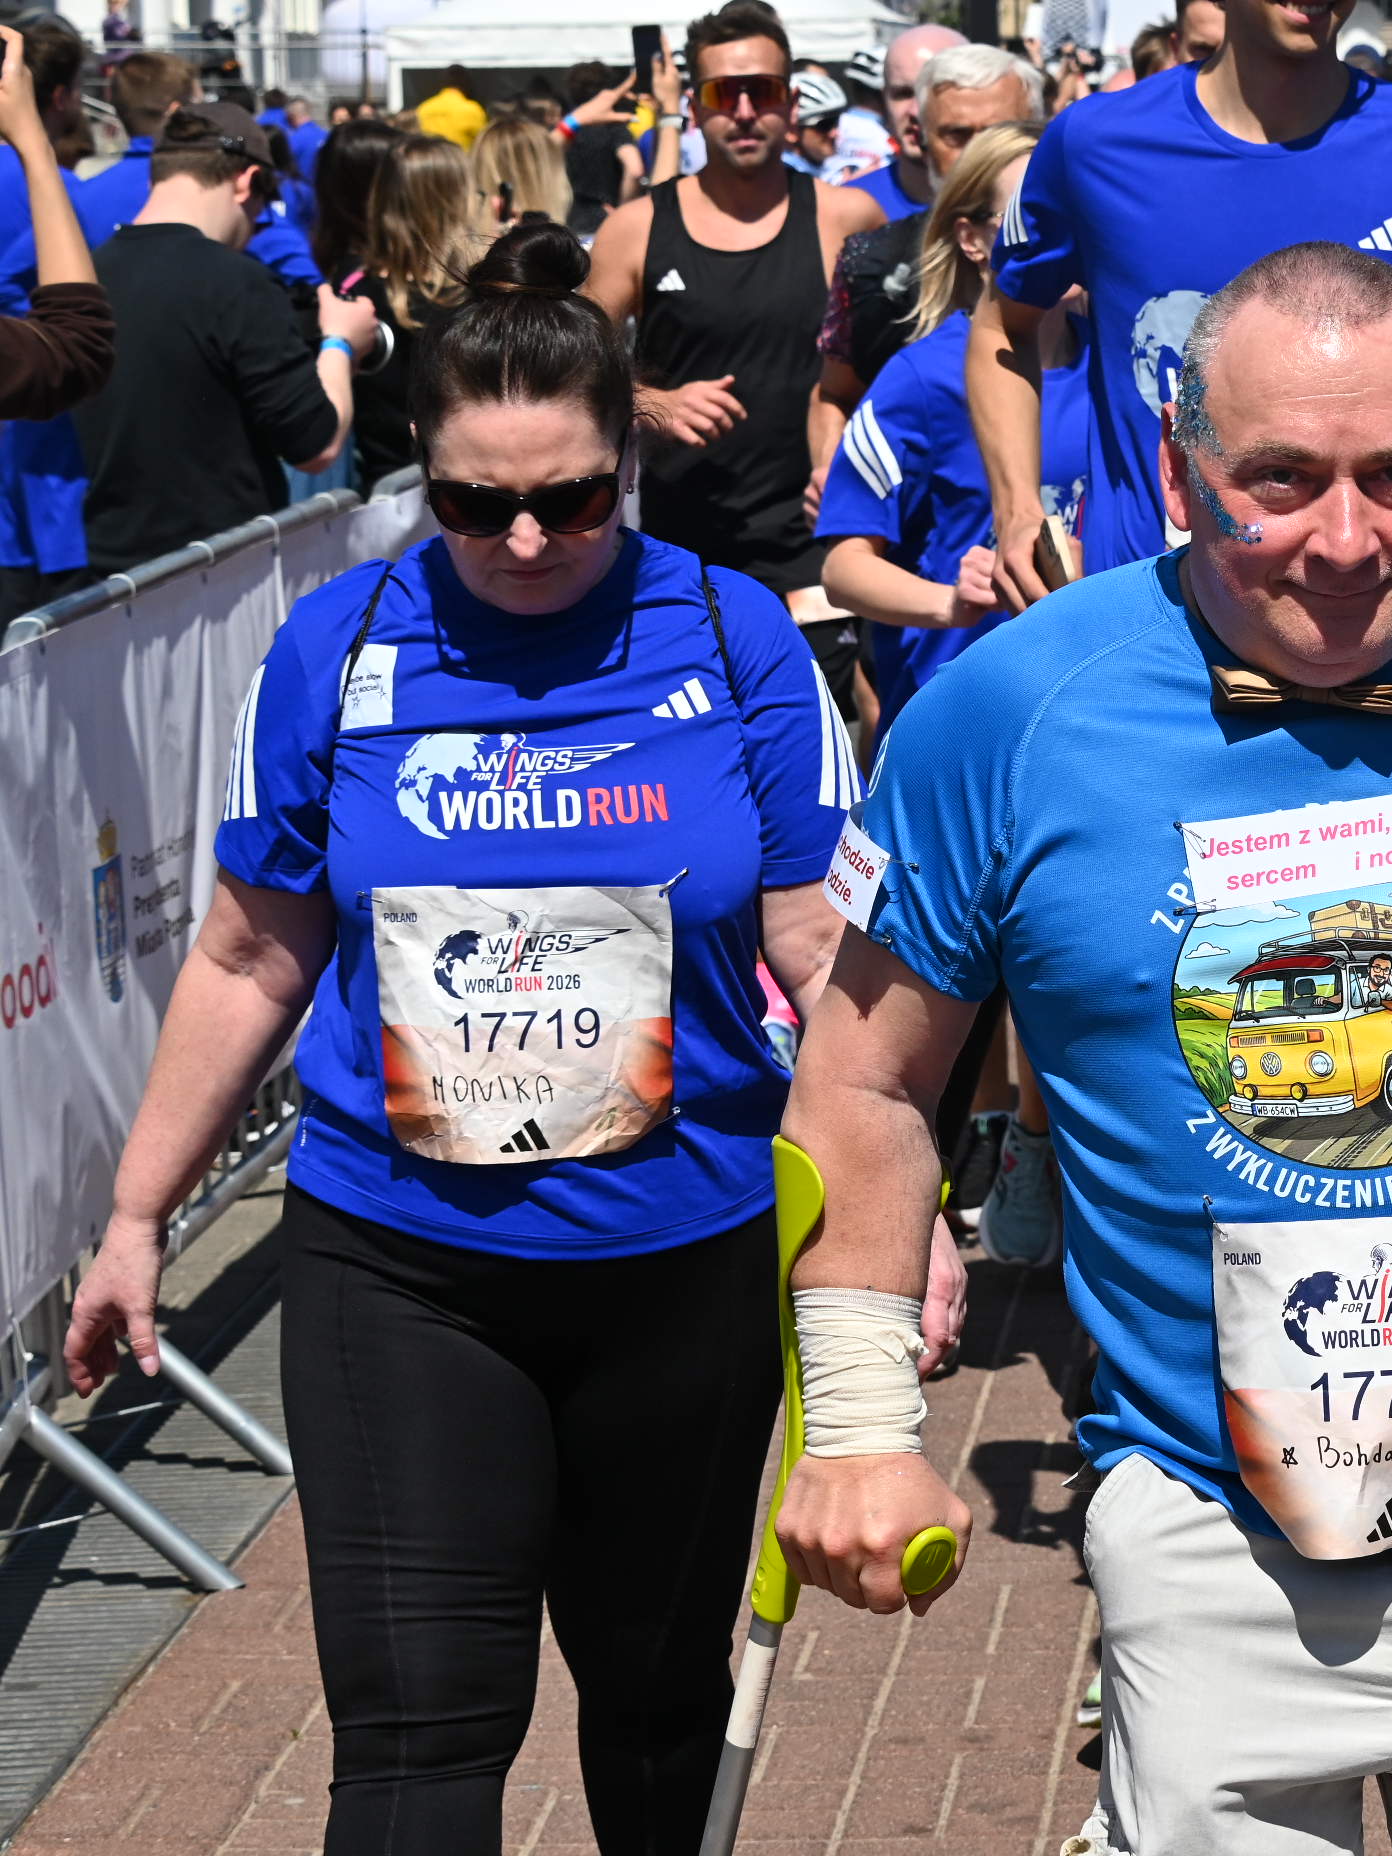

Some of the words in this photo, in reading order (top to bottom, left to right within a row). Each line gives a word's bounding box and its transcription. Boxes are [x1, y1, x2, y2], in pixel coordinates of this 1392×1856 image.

[477, 749, 574, 773] WINGS
[471, 772, 492, 781] FOR
[490, 771, 548, 791] LIFE
[1203, 826, 1291, 859] Jestem
[1298, 828, 1312, 845] z
[1319, 812, 1391, 842] wami,
[1226, 861, 1318, 891] sercem
[1355, 850, 1361, 871] i
[383, 912, 418, 923] POLAND
[1151, 909, 1185, 935] Z
[487, 932, 574, 956] WINGS
[481, 956, 499, 965] FOR
[497, 954, 547, 975] LIFE
[547, 974, 581, 991] 2026
[453, 1006, 601, 1054] 17719
[432, 1074, 555, 1105] MONIKA
[1185, 1109, 1216, 1134] Z
[1223, 1252, 1261, 1265] POLAND
[1341, 1302, 1363, 1314] FOR
